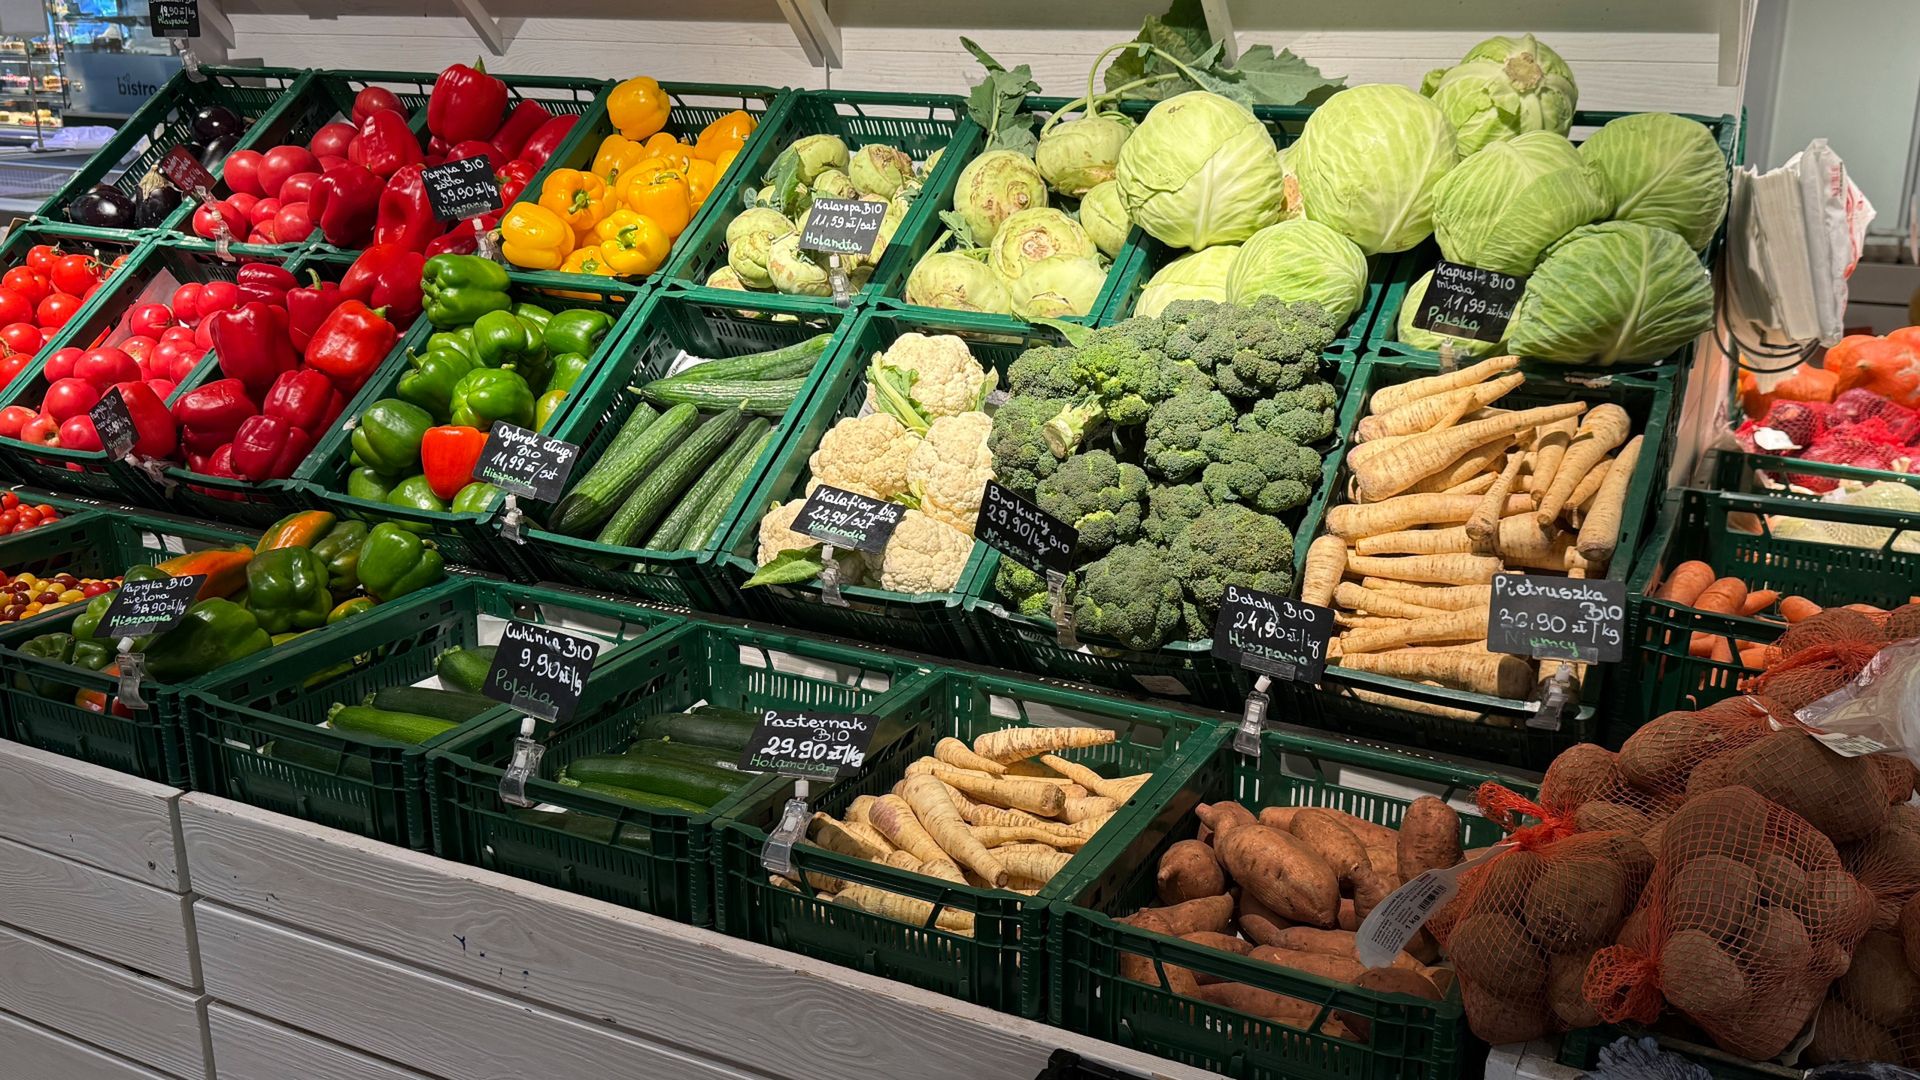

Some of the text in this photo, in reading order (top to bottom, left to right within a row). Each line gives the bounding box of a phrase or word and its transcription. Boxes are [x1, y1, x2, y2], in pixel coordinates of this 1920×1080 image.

[117, 76, 158, 96] bistro
[421, 159, 484, 180] Papryka BIO
[438, 200, 492, 216] Hiszpania
[861, 203, 882, 214] BIO
[812, 214, 845, 228] 11,59
[805, 232, 863, 251] Holandia
[1489, 273, 1515, 290] BIO
[1444, 294, 1486, 313] 11,99
[1426, 305, 1480, 329] Polska
[498, 425, 539, 448] Ogórek
[491, 451, 525, 471] 11,99
[516, 445, 541, 458] BIO
[482, 466, 535, 488] Hiszpania
[815, 488, 876, 511] Kalafior
[807, 520, 867, 541] Holandia
[1049, 535, 1070, 554] BIO
[122, 576, 193, 595] Papryka BIO
[1495, 575, 1608, 602] Pietruszka
[123, 592, 170, 605] zielona
[1226, 586, 1315, 623] Bataty BIO
[110, 612, 172, 628] Hiszpania
[1579, 601, 1623, 621] BIO
[1233, 610, 1286, 638] 24,90
[506, 622, 593, 660] Cukinia BIO
[1228, 629, 1308, 665] Hiszpania
[495, 668, 555, 706] Polska
[764, 710, 867, 731] Pasternak
[812, 727, 850, 742] BIO
[760, 736, 827, 760] 29,90
[750, 753, 837, 772] Holandia
